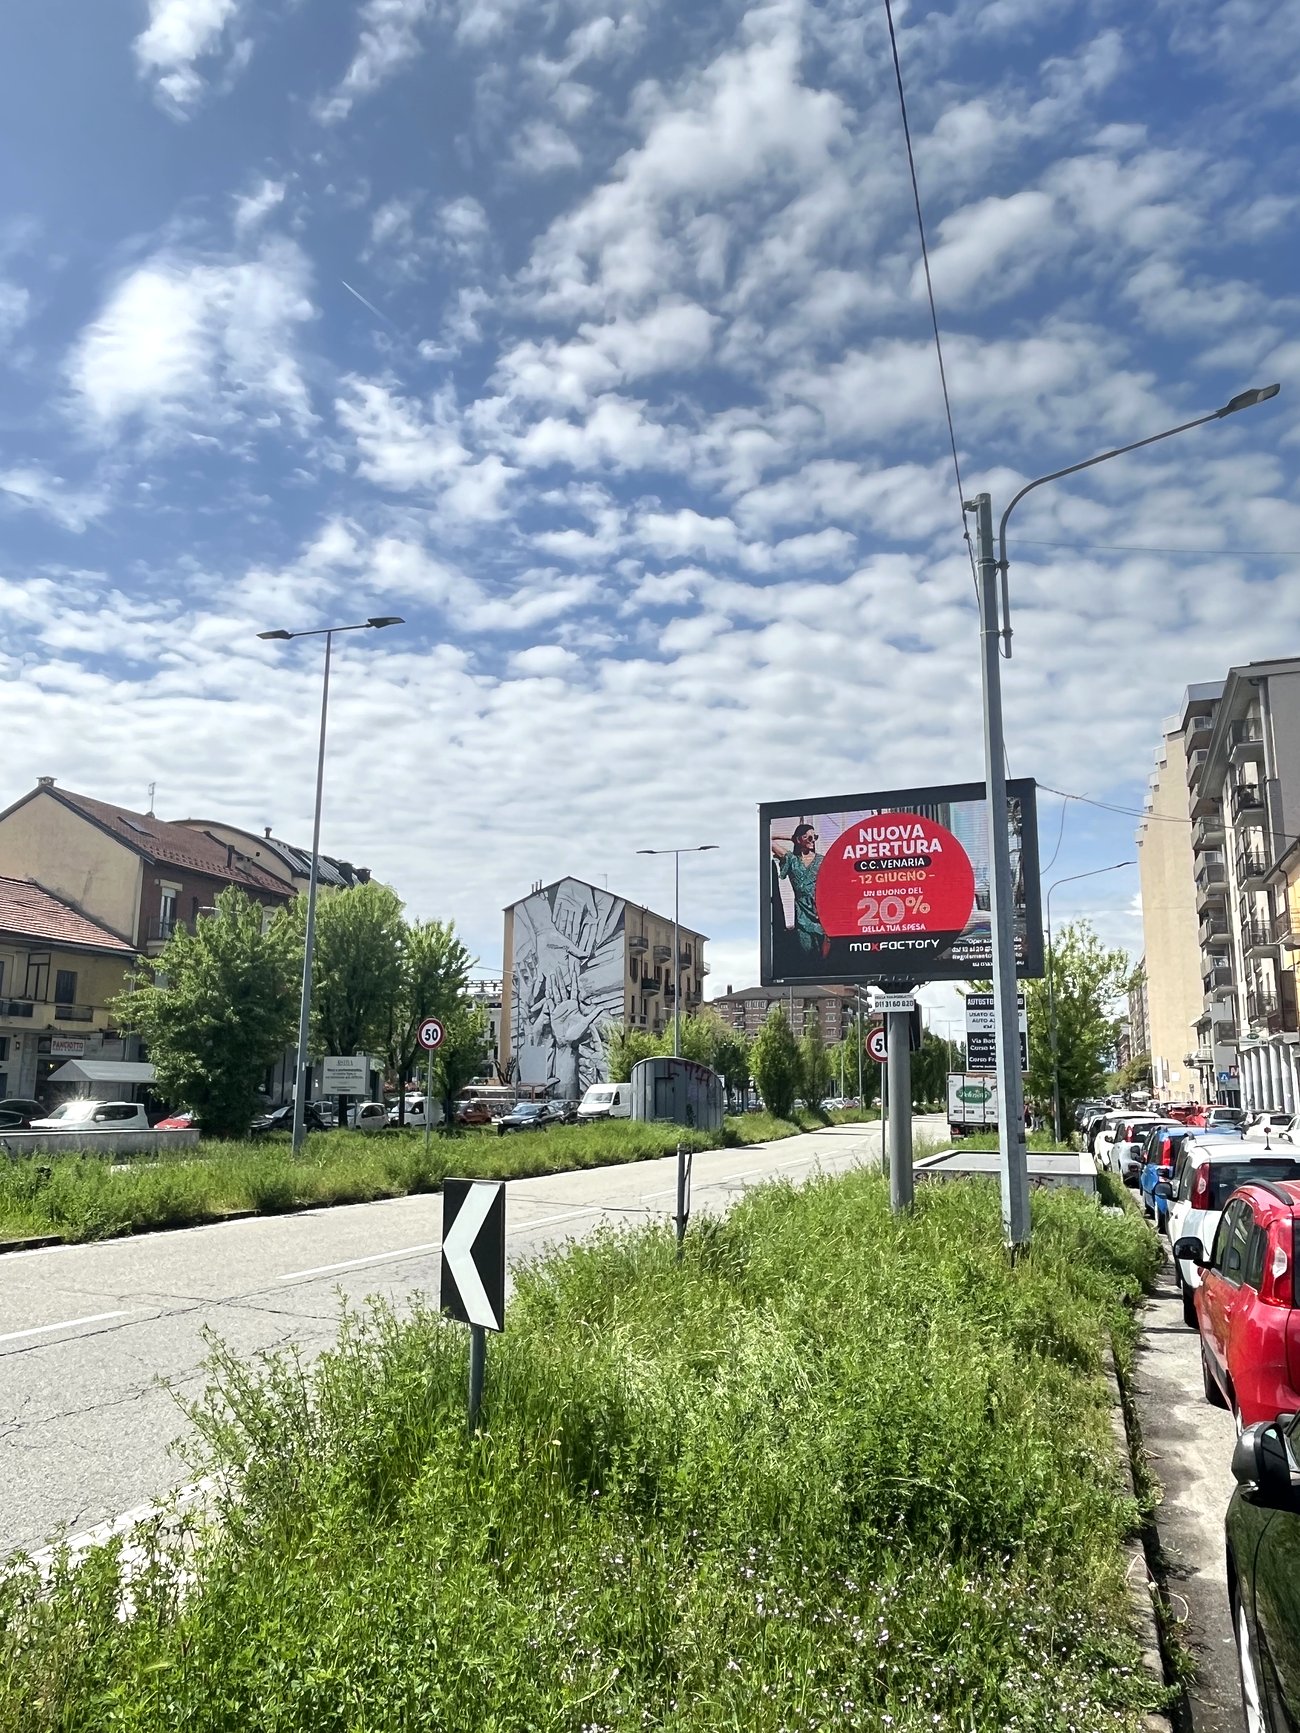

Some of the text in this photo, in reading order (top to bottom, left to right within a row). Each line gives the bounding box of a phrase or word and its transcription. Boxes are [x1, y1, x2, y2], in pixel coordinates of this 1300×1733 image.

[859, 824, 925, 843] NUOVA
[842, 838, 943, 860] APERTURA
[860, 858, 925, 870] C.C. VENARIA
[859, 870, 927, 884] 12 GIUGNO
[863, 887, 923, 897] UN BUONO DEL
[857, 895, 931, 926] 20%
[862, 923, 926, 933] DELLA TUA SPESA
[424, 1028, 439, 1042] 50
